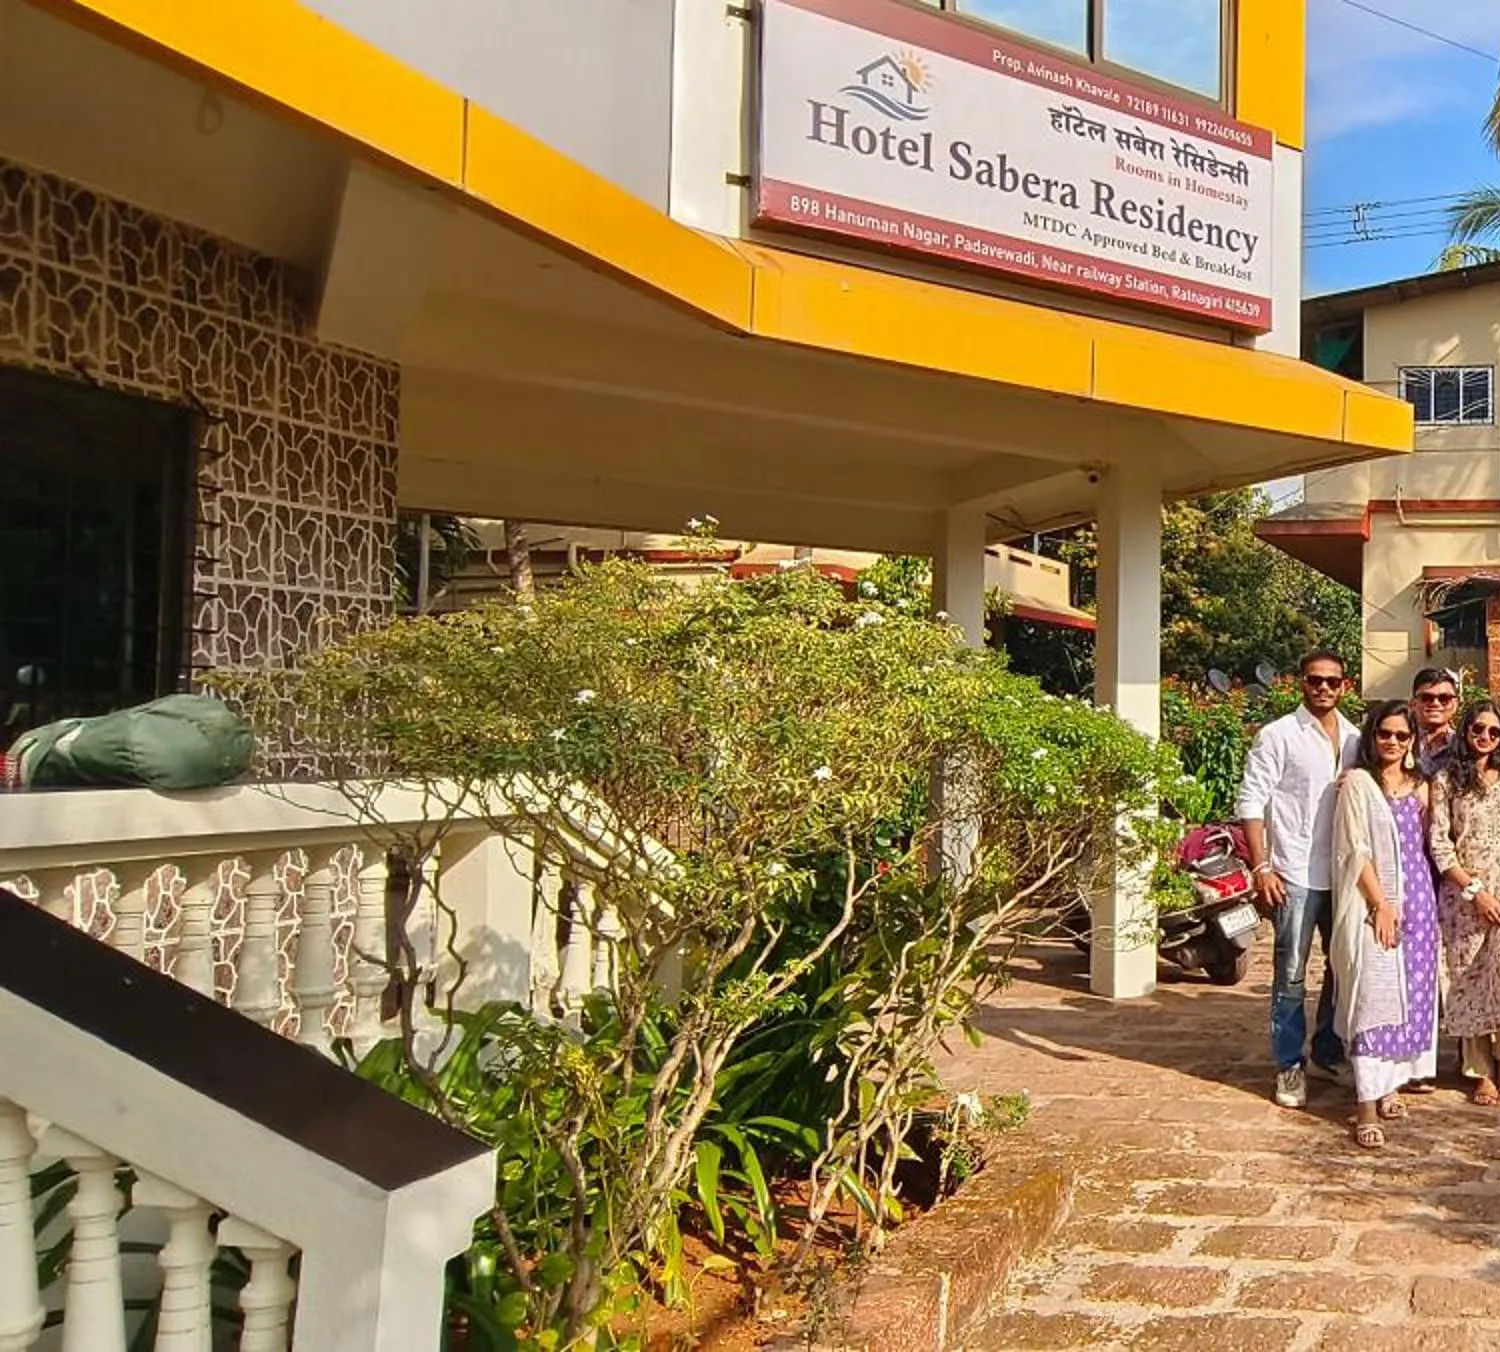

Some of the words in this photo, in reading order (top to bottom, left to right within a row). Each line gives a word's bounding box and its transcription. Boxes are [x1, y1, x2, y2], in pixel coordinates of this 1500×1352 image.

[992, 49, 1025, 73] Prop.
[1027, 61, 1073, 88] Avinash
[1126, 95, 1159, 116] 72189
[806, 99, 934, 172] Hotel
[949, 141, 1080, 210] Sabera
[1091, 179, 1259, 264] Residency
[1048, 103, 1107, 143] हॉटेल
[1113, 126, 1165, 161] सबेरा
[1170, 137, 1250, 187] रेसिडेन्सी
[1115, 156, 1164, 183] Rooms
[1167, 175, 1181, 188] in
[1184, 179, 1249, 210] Homestay
[790, 195, 820, 217] 898
[824, 203, 899, 234] Hanuman
[1041, 255, 1074, 276] Near
[1076, 265, 1123, 289] railway
[1023, 211, 1077, 237] MTDC
[1081, 226, 1148, 256] Approved
[1151, 244, 1177, 262] Bed
[1179, 251, 1192, 267] &
[1195, 255, 1252, 282] Breakfast
